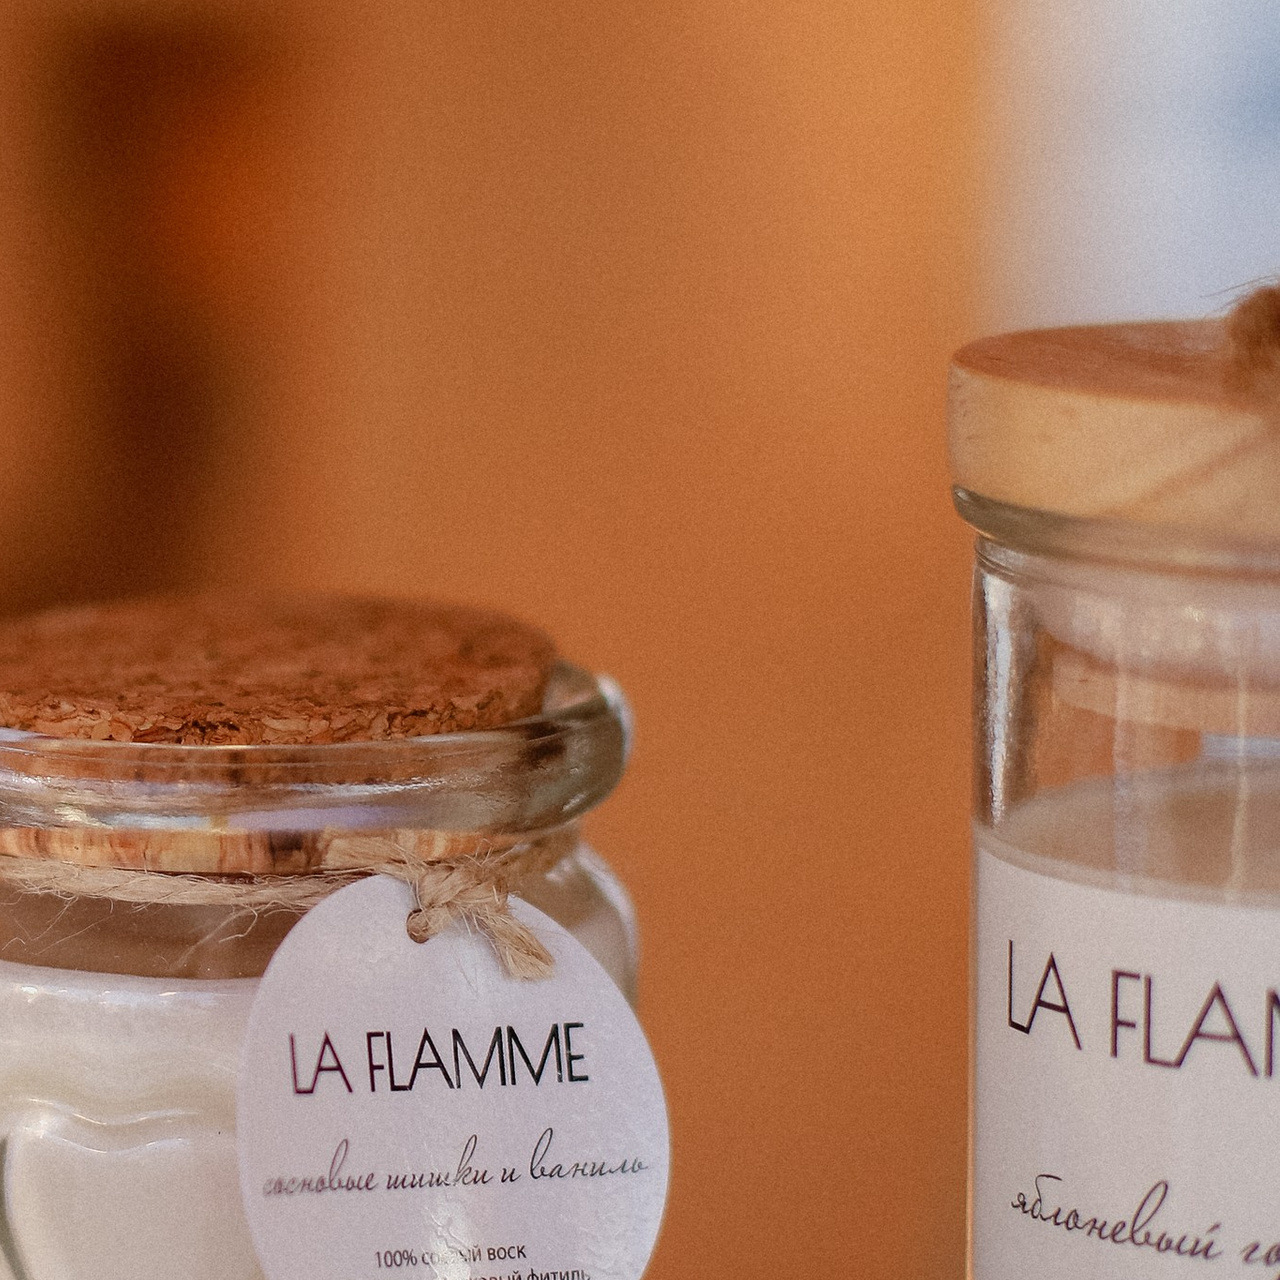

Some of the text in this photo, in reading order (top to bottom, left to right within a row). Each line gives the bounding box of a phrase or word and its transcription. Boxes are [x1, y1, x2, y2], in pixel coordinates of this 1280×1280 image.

[1007, 938, 1083, 1052] LA
[289, 1021, 590, 1096] LA FLAMME
[262, 1126, 652, 1196] сосновые шишки и ваниль
[1010, 1173, 1224, 1261] яблоневый
[375, 1248, 418, 1268] 100%
[487, 1244, 527, 1261] воск
